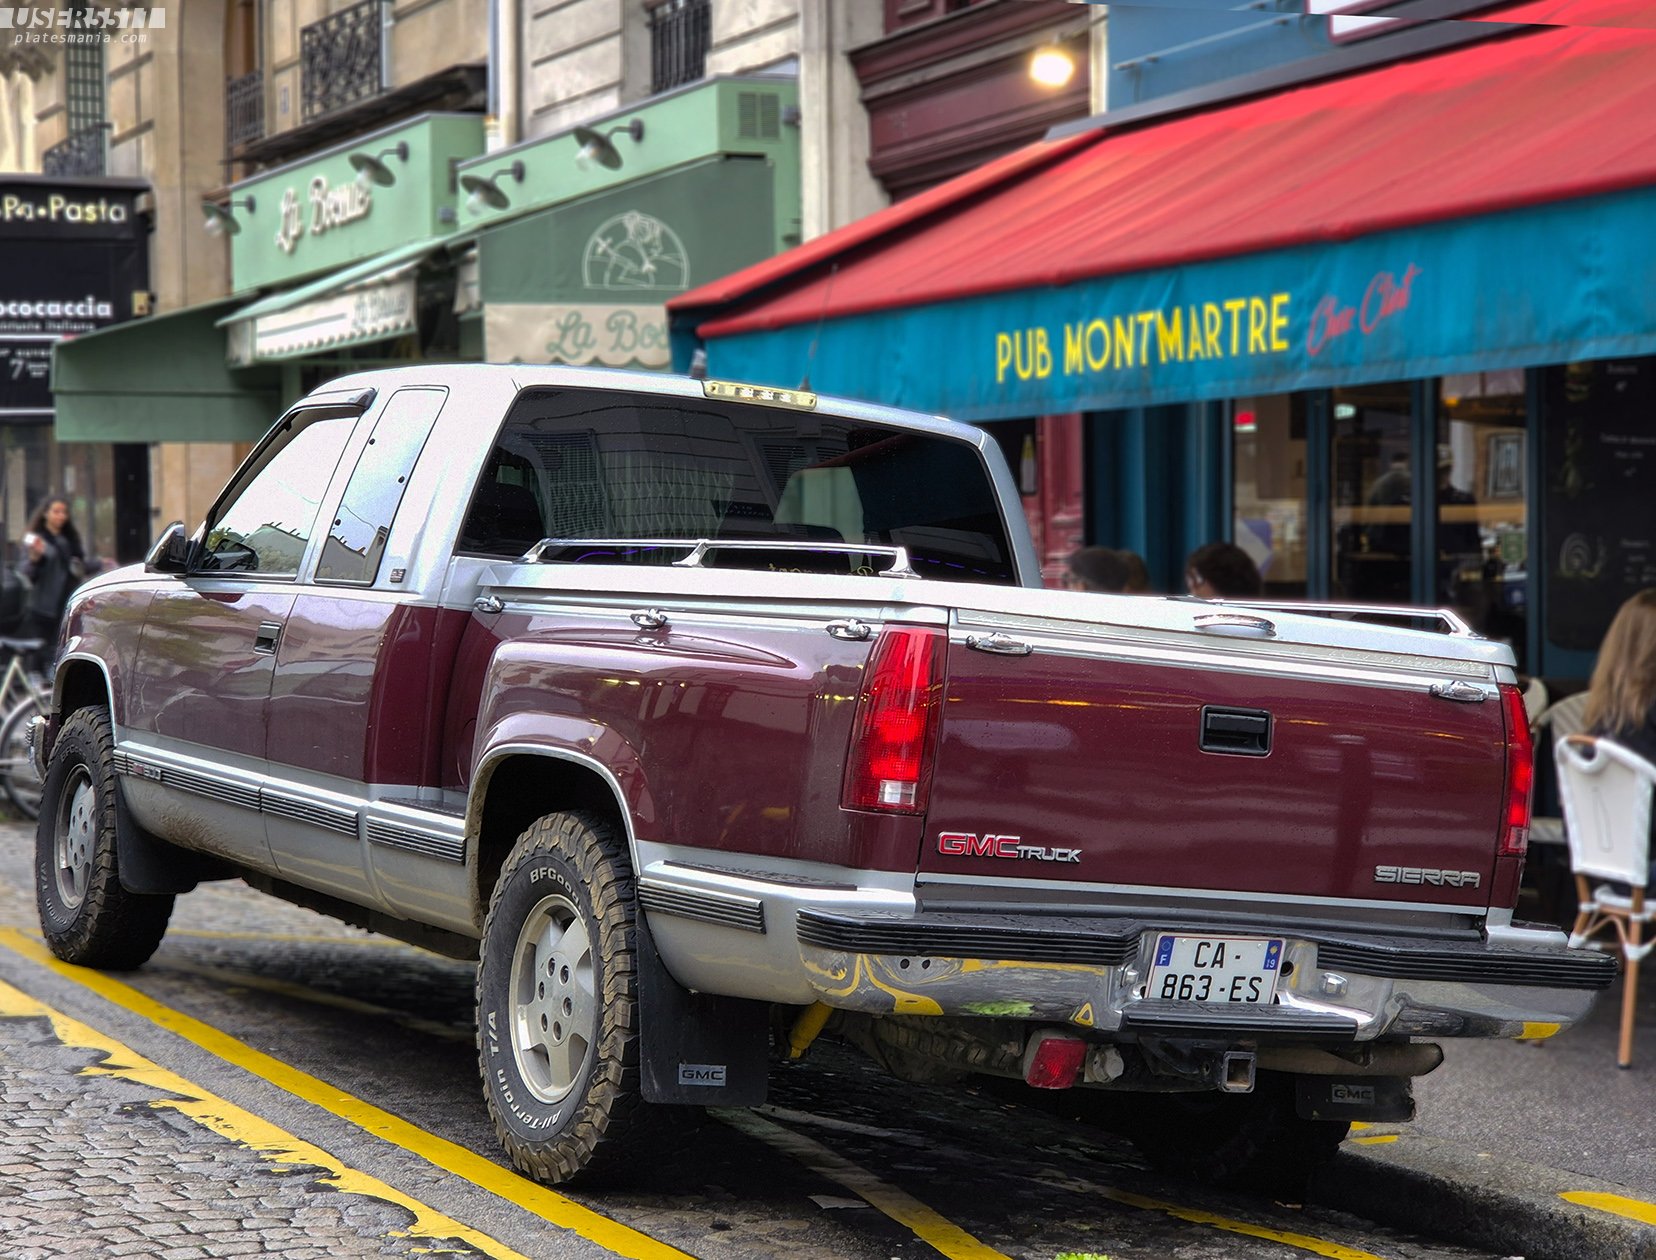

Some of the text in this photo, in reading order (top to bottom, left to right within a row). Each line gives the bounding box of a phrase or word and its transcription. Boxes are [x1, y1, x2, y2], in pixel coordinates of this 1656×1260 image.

[545, 310, 597, 359] La
[996, 328, 1052, 383] PUB
[1065, 293, 1290, 376] MONTMARTRE
[938, 831, 1082, 863] GMC TRUCK
[1374, 865, 1481, 889] SIERRA
[1159, 954, 1168, 965] F
[1266, 959, 1276, 969] 19
[488, 1011, 562, 1130] All-Terrain T/A
[681, 1068, 725, 1080] GMC
[1334, 1089, 1373, 1100] GMC
